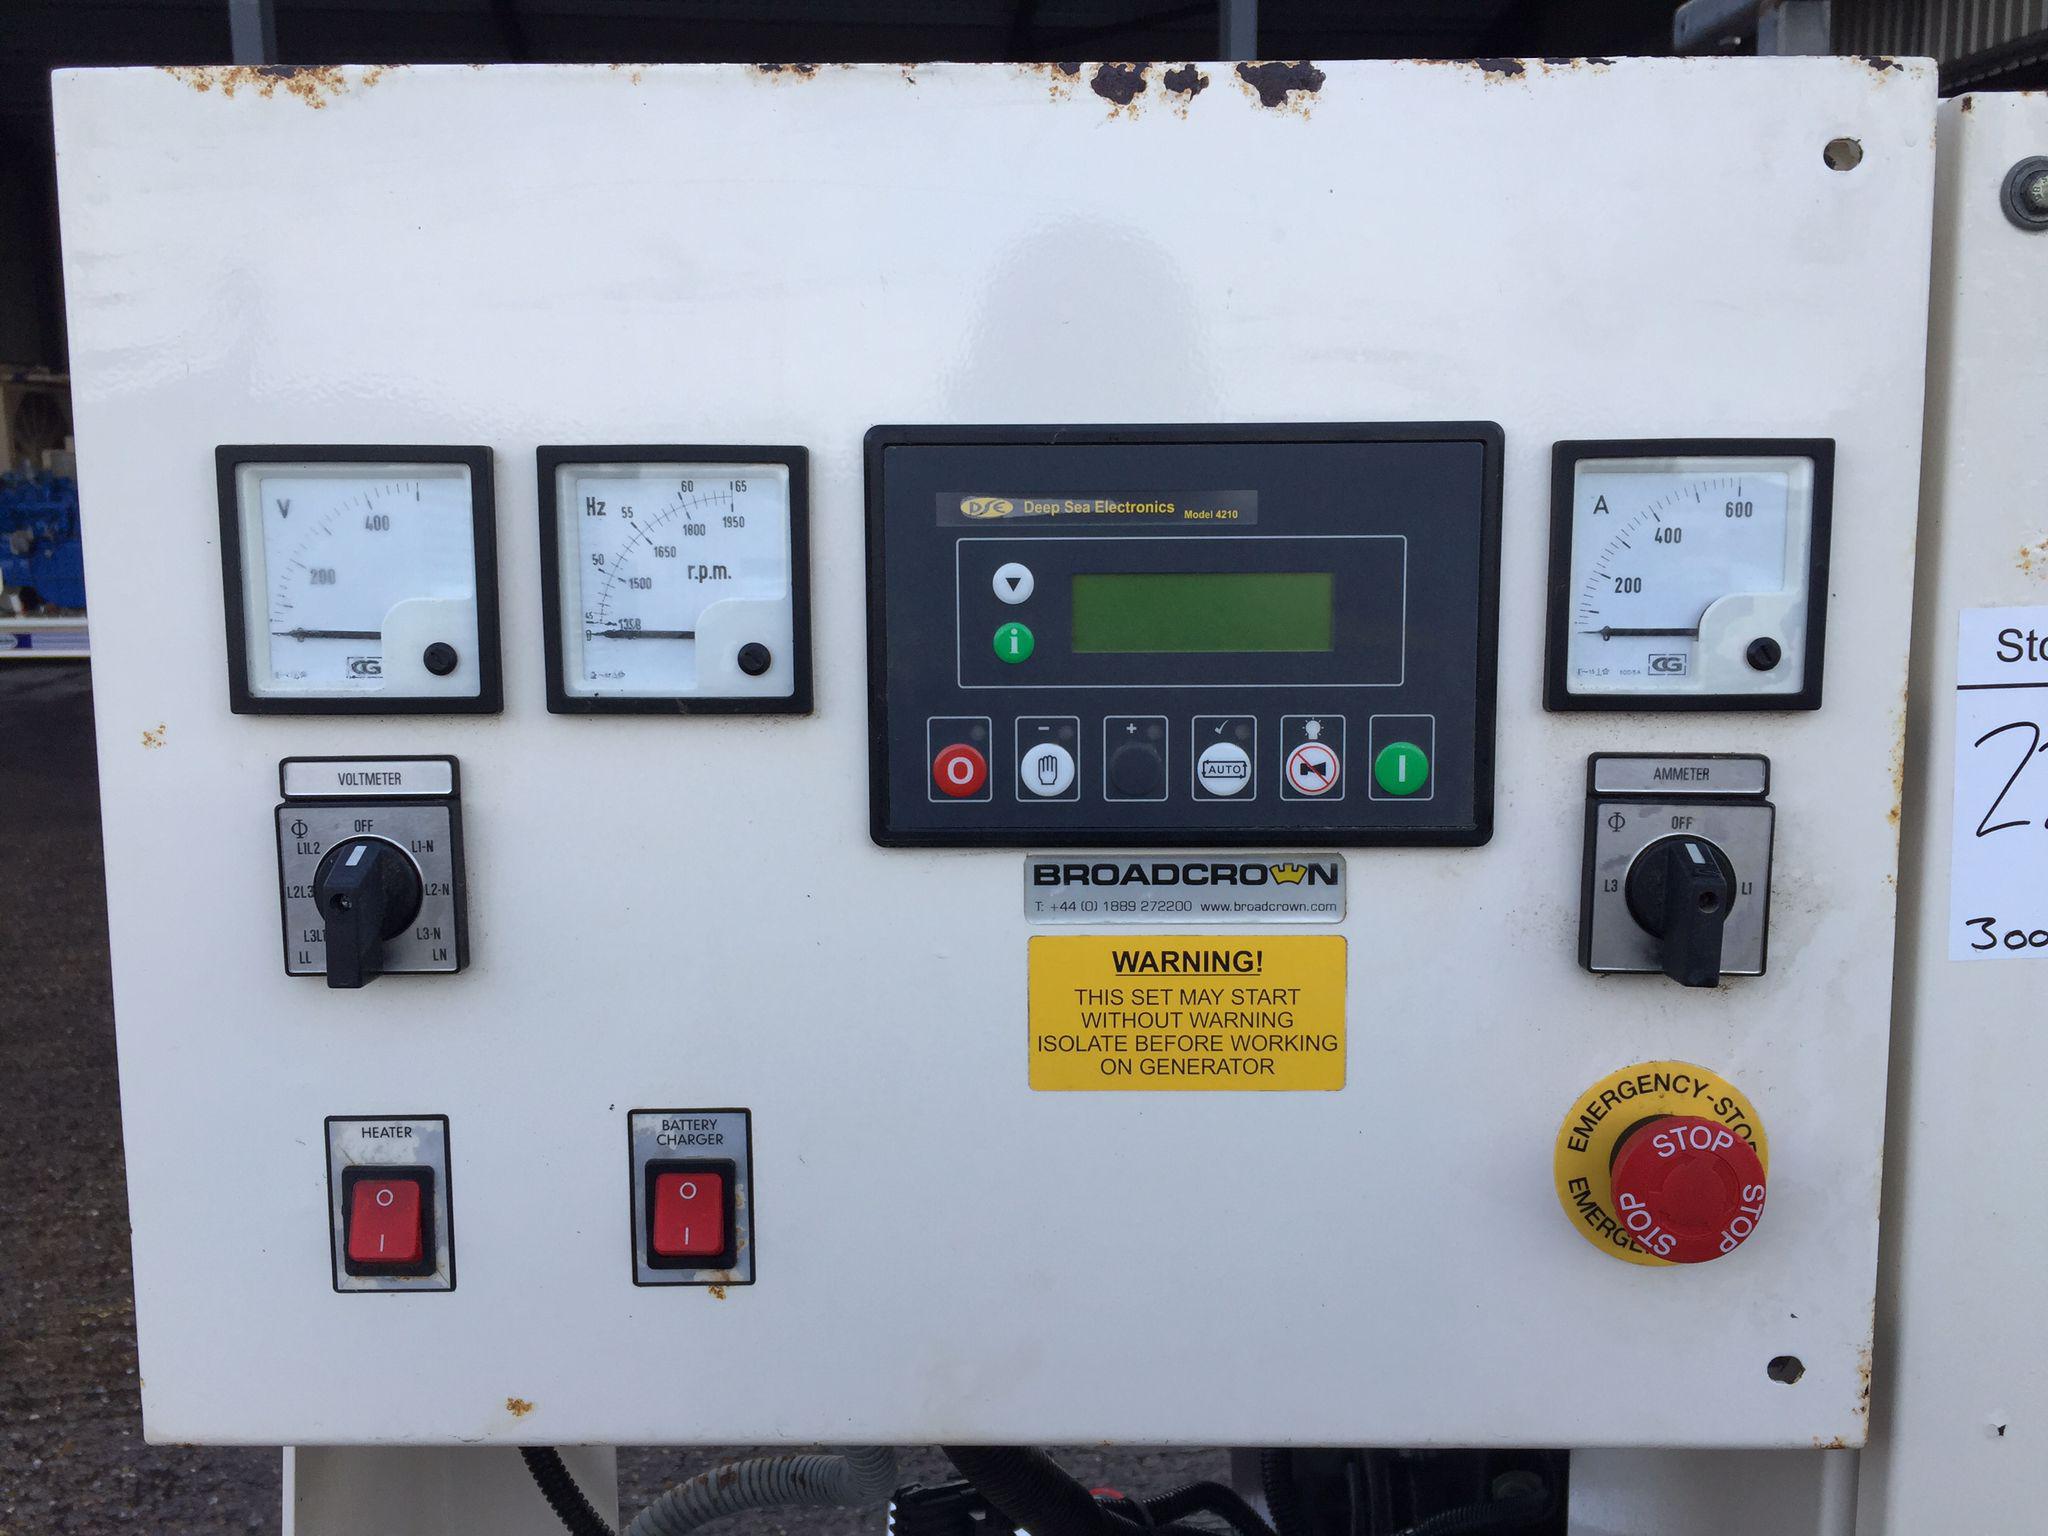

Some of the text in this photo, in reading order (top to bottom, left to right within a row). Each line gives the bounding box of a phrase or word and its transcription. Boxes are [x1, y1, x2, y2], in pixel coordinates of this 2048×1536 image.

[682, 481, 694, 493] 60
[735, 480, 747, 492] 65
[277, 498, 290, 519] V
[586, 497, 607, 516] Hz
[1023, 500, 1060, 516] Deep
[1064, 500, 1091, 514] Sea
[1095, 500, 1175, 514] Electronics
[1593, 495, 1609, 514] A
[1725, 502, 1753, 518] 600
[621, 507, 634, 518] 55
[1184, 510, 1238, 519] Model 4210
[365, 515, 390, 531] 400
[723, 516, 745, 528] 1950
[683, 524, 706, 536] 1800
[1654, 527, 1682, 544] 400
[654, 546, 676, 558] 1650
[592, 554, 604, 566] 50
[309, 568, 336, 585] 200
[687, 565, 732, 583] r.p.m.
[629, 577, 652, 589] 1500
[1615, 577, 1641, 593] 200
[1208, 764, 1242, 775] AUTO
[1653, 767, 1710, 781] AMMETER
[338, 772, 402, 786] VOLTMETER
[1974, 721, 2048, 837] 2
[354, 819, 374, 833] OFF
[1672, 816, 1693, 829] OFF
[297, 842, 320, 855] L1L2
[411, 840, 434, 853] L1-N
[1033, 863, 1338, 886] BROADCROWN
[287, 886, 314, 899] L2L3
[425, 884, 450, 896] L2-N
[1604, 879, 1618, 892] L3
[1742, 882, 1752, 895] L1
[1035, 900, 1337, 913] T: +44 (0) 1889 272200 www.broadcrown.com
[417, 928, 441, 940] L3-N
[299, 951, 312, 964] LL
[433, 949, 447, 961] LN
[1112, 950, 1263, 975] WARNING!
[1075, 988, 1300, 1006] THIS SET MAY START
[1081, 1012, 1294, 1029] WITHOUT WARNING
[1038, 1034, 1338, 1052] ISOLATE BEFORE WORKING
[1100, 1058, 1275, 1075] ON GENERATOR
[662, 1118, 717, 1132] BATTERY
[361, 1126, 412, 1140] HEATER
[656, 1132, 724, 1146] CHARGER
[1652, 1125, 1734, 1158] STOP
[1618, 1192, 1677, 1256] STOP
[1718, 1184, 1765, 1253] STOP
